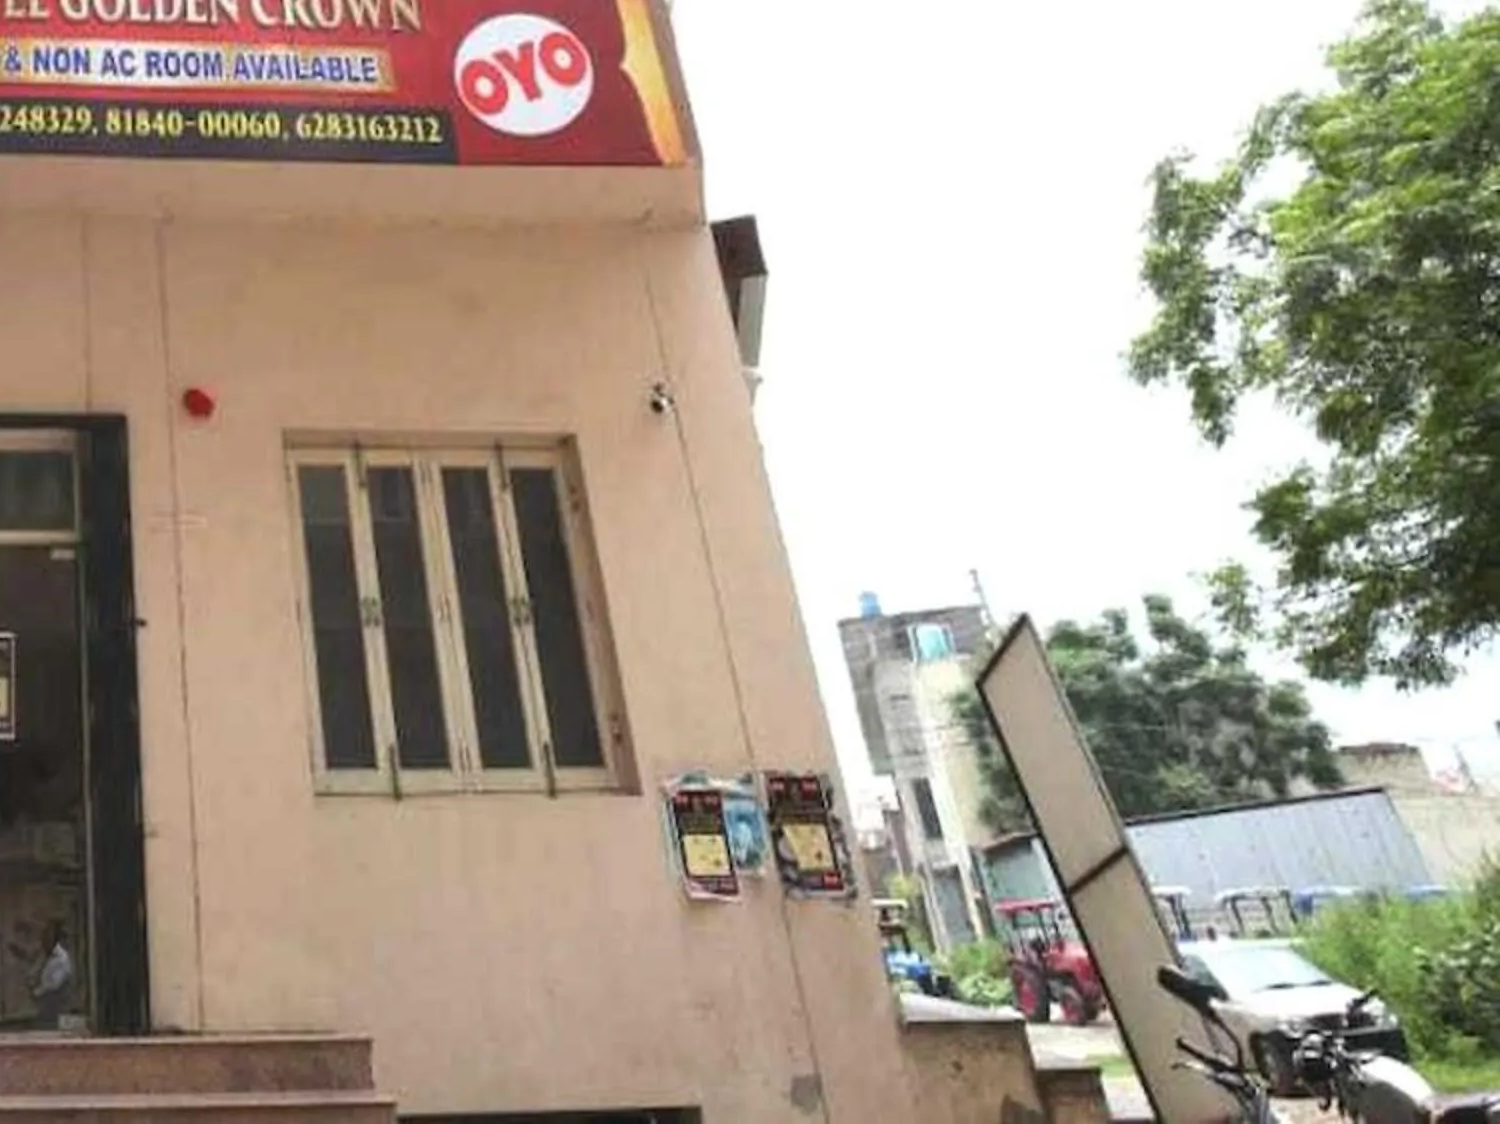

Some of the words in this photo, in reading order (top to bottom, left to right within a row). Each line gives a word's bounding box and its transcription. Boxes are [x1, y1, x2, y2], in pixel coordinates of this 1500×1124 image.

[3, 47, 24, 74] &
[32, 48, 92, 76] NON
[100, 49, 137, 77] AC
[145, 51, 223, 80] ROOM
[232, 53, 379, 84] AVAILABLE
[460, 31, 588, 117] OYO
[105, 110, 289, 141] 81840-00060,
[296, 113, 443, 144] 6283163212
